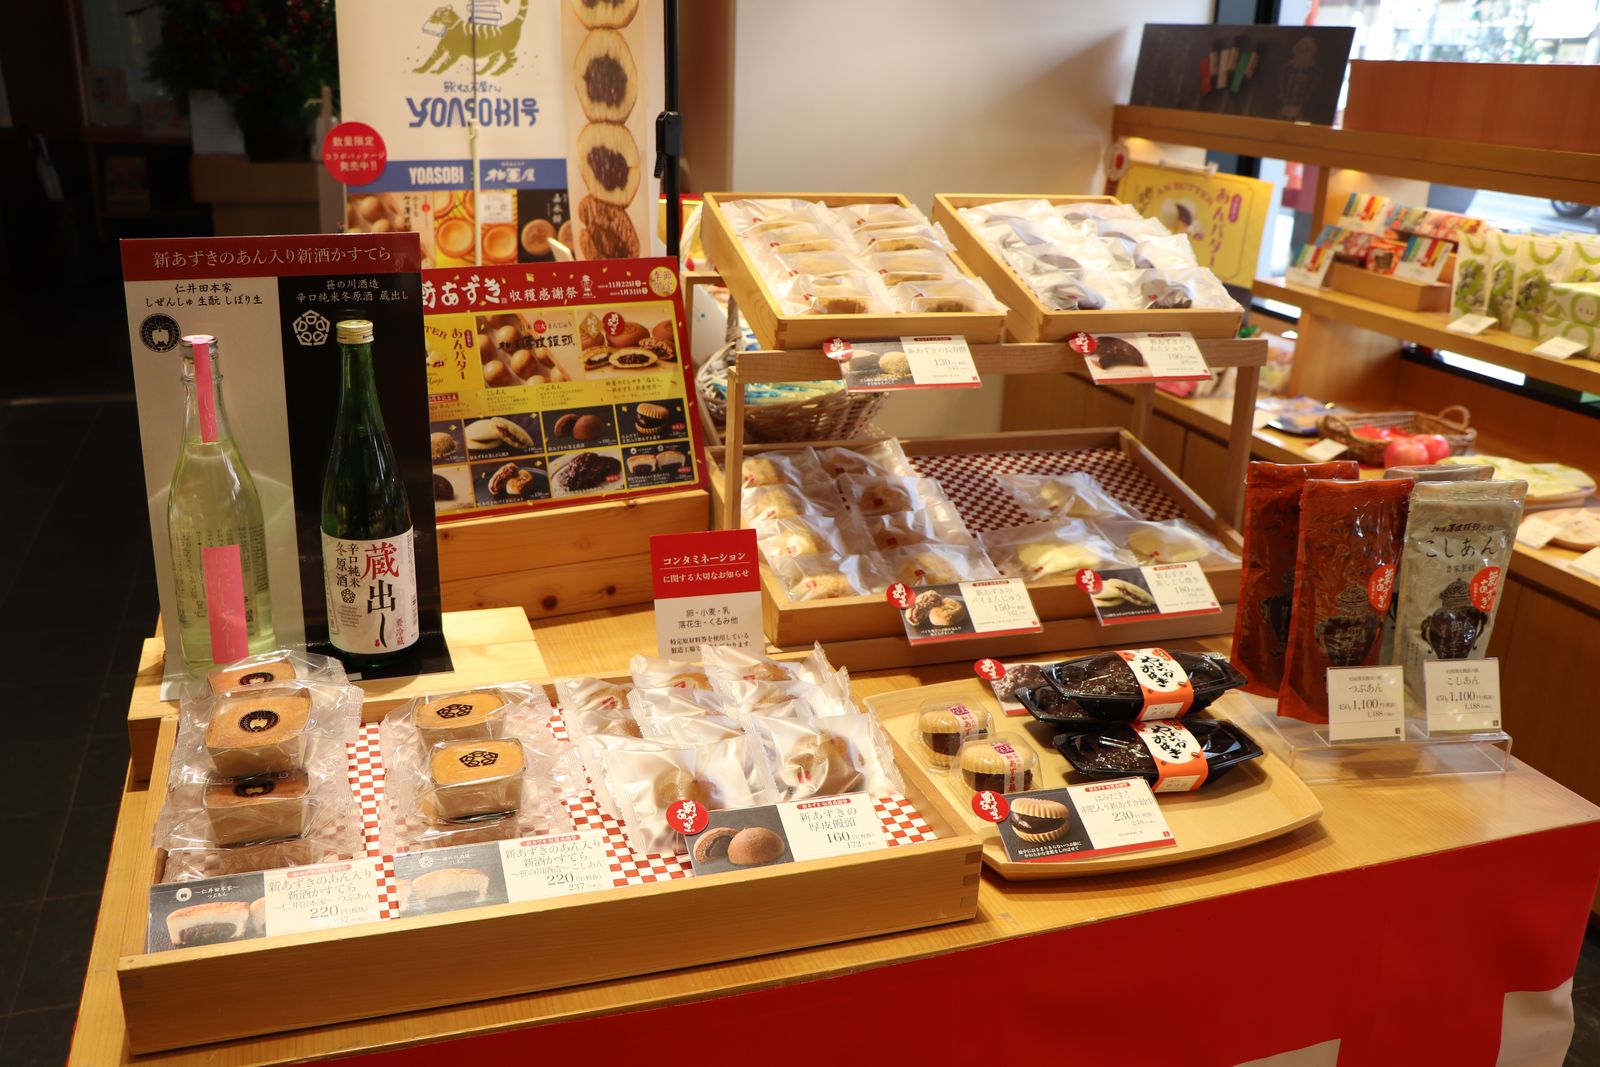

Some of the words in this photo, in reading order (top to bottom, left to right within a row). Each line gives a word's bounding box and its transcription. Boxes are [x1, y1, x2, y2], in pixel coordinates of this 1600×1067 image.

[408, 166, 465, 185] YOASOBI
[152, 246, 392, 270] 新あずきのあん入り新酒かすてら
[175, 282, 233, 294] 仁井田本家
[326, 278, 380, 290] 笹の川酒造
[146, 297, 193, 308] しぜんしゅ
[225, 294, 263, 305] しぼり生
[296, 291, 374, 304] 辛口純米冬原酒
[380, 290, 409, 302] 蔵出し
[509, 286, 578, 303] 収穫感謝祭
[451, 328, 467, 380] あんバター
[1425, 536, 1499, 558] こしあん
[335, 541, 348, 588] 冬原酒
[347, 543, 361, 588] 辛口純米
[663, 552, 746, 566] コンタミネーション
[663, 569, 750, 583] に関する大切なお知らせ
[360, 541, 400, 648] 蔵出し
[686, 606, 731, 618] 卵・小麦・乳
[993, 603, 1010, 612] 150
[678, 617, 739, 629] 落花生・くるみ他
[1447, 675, 1480, 686] こしあん
[1347, 683, 1383, 694] つぶあん
[1450, 691, 1476, 702] 1,100
[1353, 699, 1379, 710] 1,100
[979, 790, 1000, 820] 新あずき
[676, 800, 698, 833] 新あずき
[799, 807, 857, 822] 新あずきの
[1111, 810, 1134, 822] 230
[808, 817, 857, 832] 厚皮饅頭
[826, 831, 851, 843] 160
[504, 839, 601, 860] 新あずきのあん入り
[523, 852, 588, 868] 新酒かすてら
[269, 868, 372, 893] 新あずきのあん入り
[546, 872, 574, 886] 220
[288, 882, 357, 901] 新酒かすてら
[309, 904, 340, 919] 220
